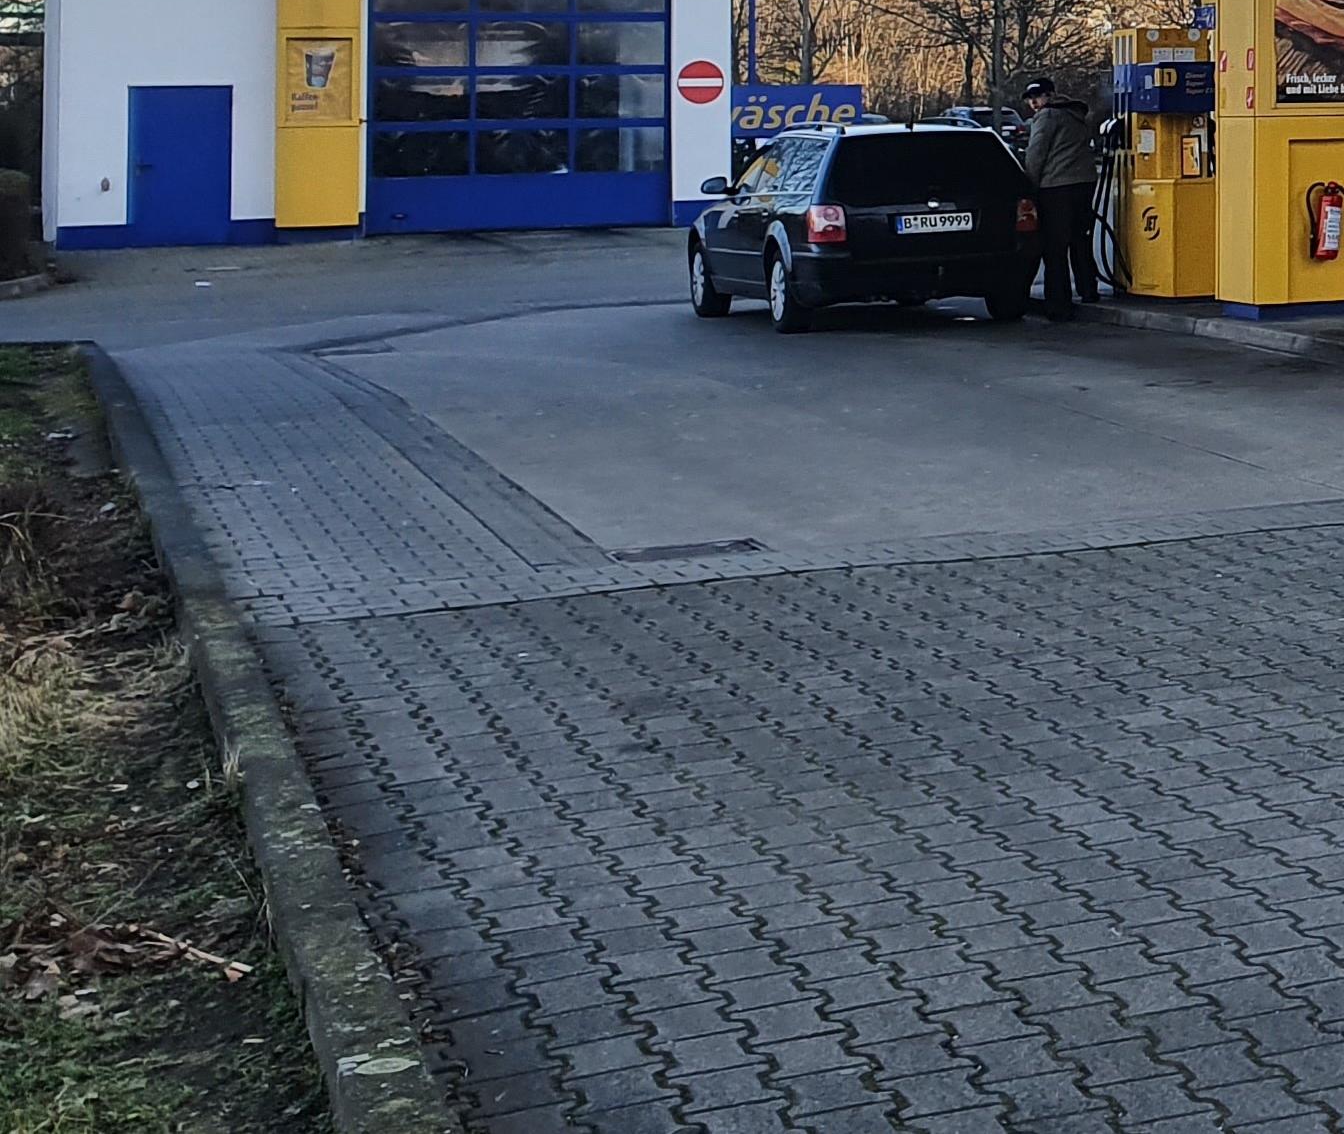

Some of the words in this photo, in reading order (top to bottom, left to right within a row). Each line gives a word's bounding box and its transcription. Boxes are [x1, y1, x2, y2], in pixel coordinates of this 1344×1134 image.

[1285, 72, 1312, 85] Frisch,
[1312, 72, 1337, 84] lecker
[1285, 84, 1302, 95] und
[1302, 84, 1318, 94] mit
[1318, 83, 1339, 94] Liebe
[904, 218, 912, 229] B
[920, 216, 937, 228] RU
[939, 214, 971, 227] 9999
